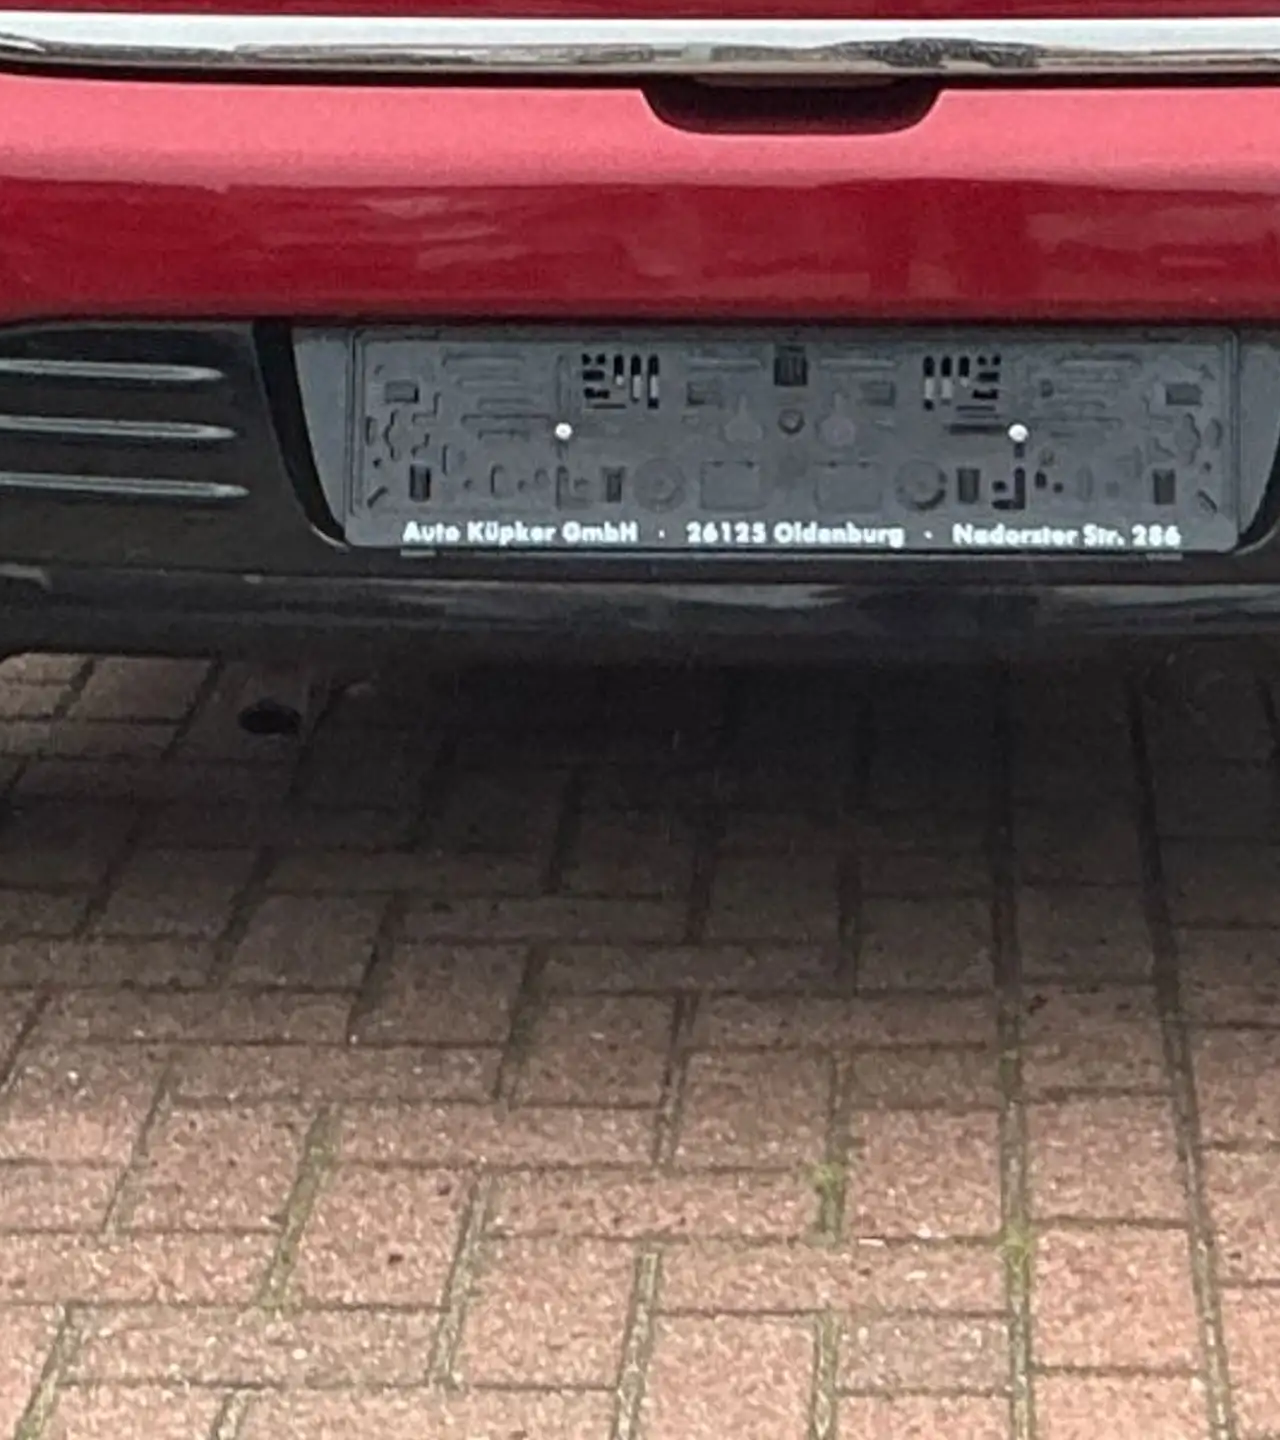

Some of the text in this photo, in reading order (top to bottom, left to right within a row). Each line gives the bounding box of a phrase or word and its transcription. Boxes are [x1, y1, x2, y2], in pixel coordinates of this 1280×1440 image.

[402, 521, 460, 542] Auto
[467, 521, 556, 546] Küpker
[562, 521, 638, 543] GmbH
[686, 521, 766, 543] 26125
[774, 521, 905, 547] Oldenburg
[1083, 523, 1125, 546] Str.
[1132, 524, 1182, 546] 286
